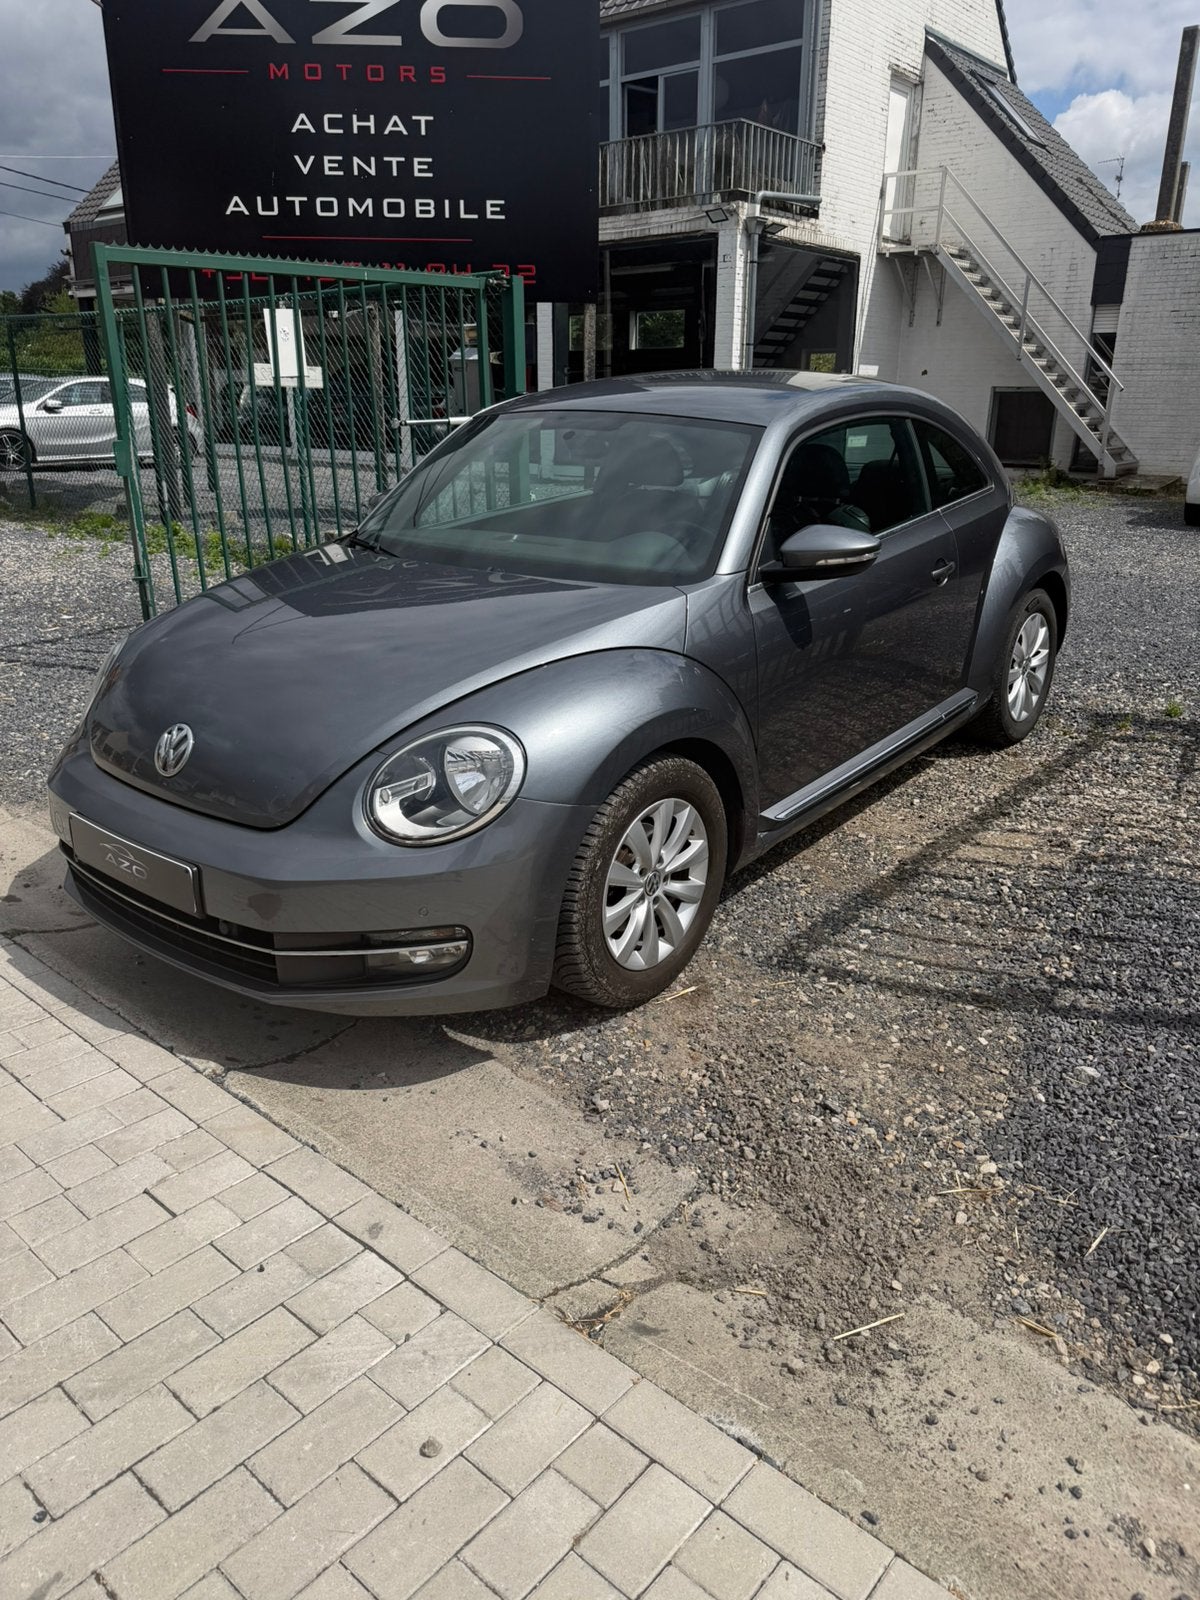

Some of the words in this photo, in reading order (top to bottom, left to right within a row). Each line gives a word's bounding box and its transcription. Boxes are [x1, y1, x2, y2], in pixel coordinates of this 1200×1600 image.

[188, 0, 524, 49] AZO
[268, 63, 446, 84] MOTORS
[291, 112, 434, 136] ACHAT
[293, 154, 434, 178] VENTE
[225, 195, 506, 220] AUTOMOBILE
[105, 852, 148, 880] AZO
